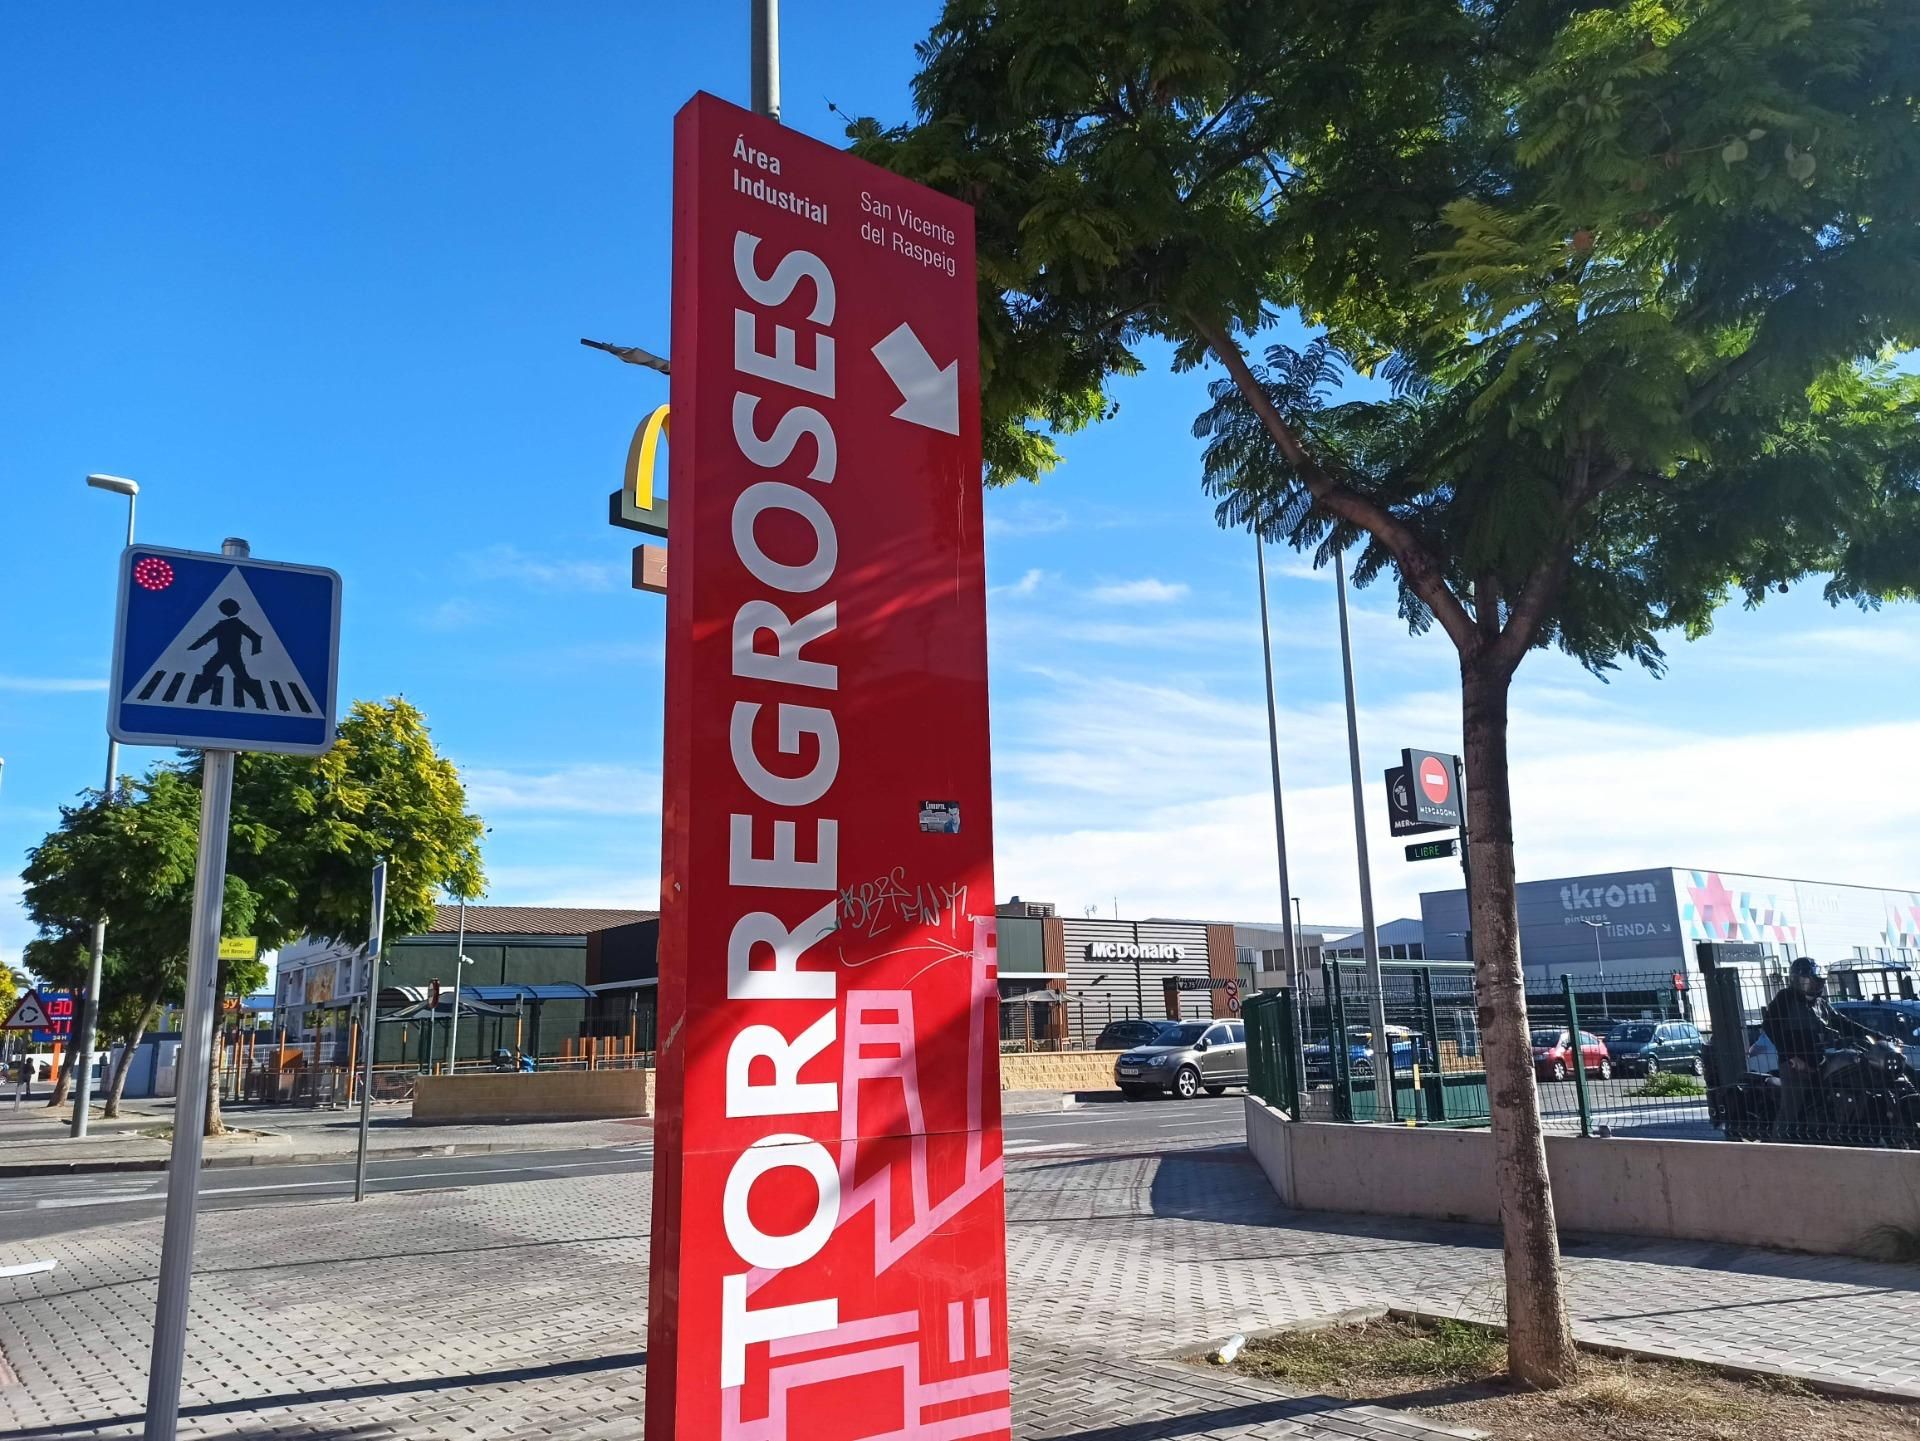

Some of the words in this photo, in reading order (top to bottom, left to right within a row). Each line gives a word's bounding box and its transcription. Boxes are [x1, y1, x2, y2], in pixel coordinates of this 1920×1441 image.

[732, 133, 781, 176] Área
[732, 169, 828, 225] Industrial
[860, 191, 892, 221] San
[897, 205, 955, 246] Vicente
[860, 222, 885, 247] del
[893, 232, 956, 277] Raspeig
[721, 230, 841, 1389] TORREGROSES
[1414, 844, 1440, 858] LIBRE
[1560, 882, 1657, 910] tkrom
[1091, 942, 1186, 960] McDonald's
[1605, 922, 1657, 938] TIENDA
